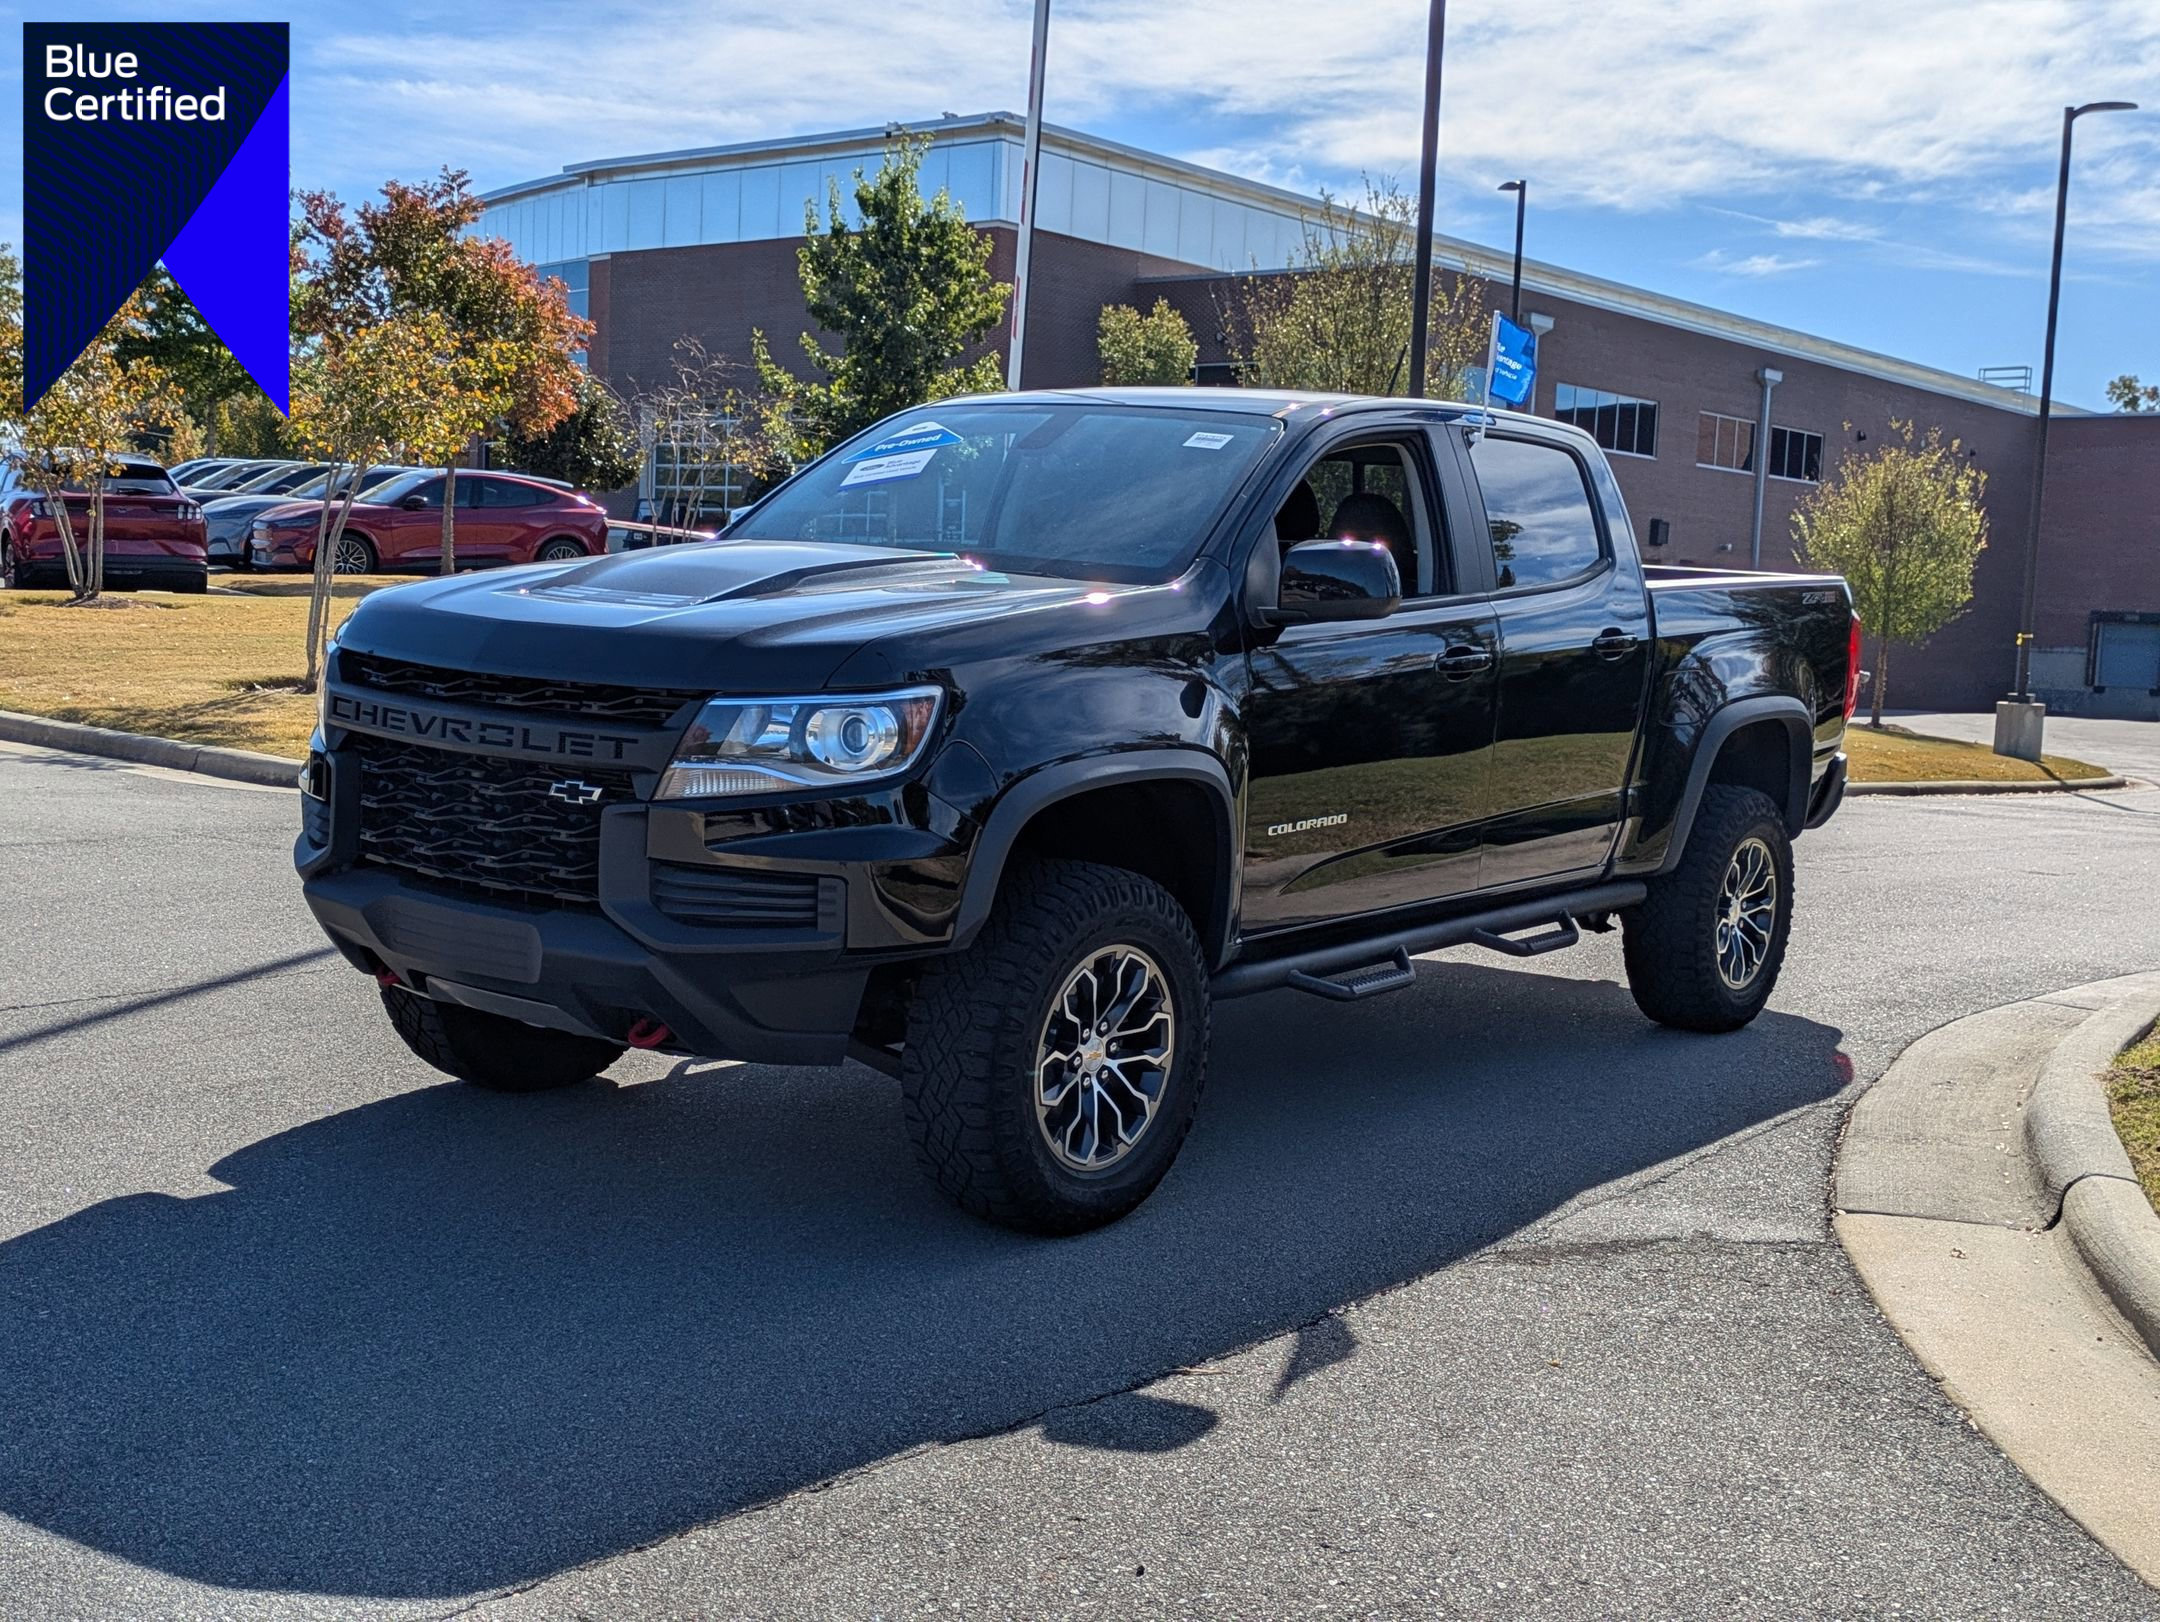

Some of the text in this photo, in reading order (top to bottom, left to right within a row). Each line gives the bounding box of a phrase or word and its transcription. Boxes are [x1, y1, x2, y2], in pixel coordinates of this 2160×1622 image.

[874, 433, 944, 452] Pre-Owned
[331, 695, 640, 760] CHEVROLET
[1267, 813, 1348, 836] COLORADO
